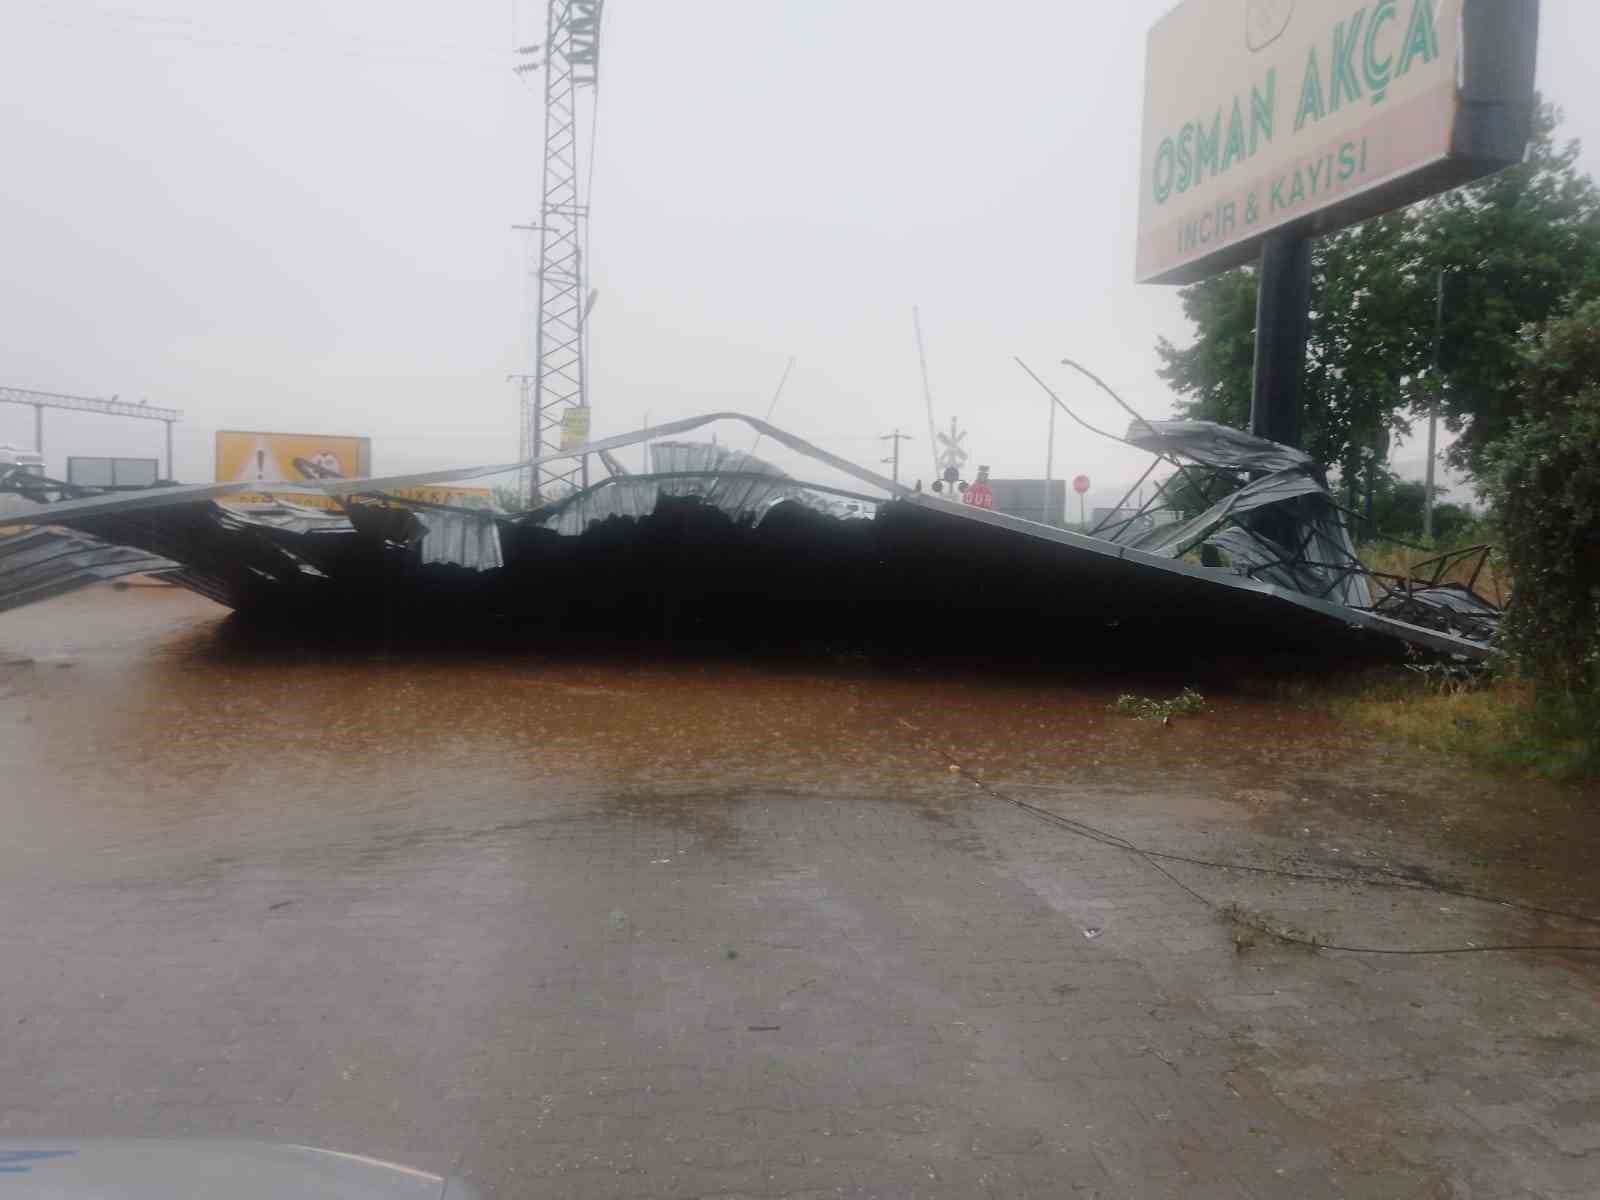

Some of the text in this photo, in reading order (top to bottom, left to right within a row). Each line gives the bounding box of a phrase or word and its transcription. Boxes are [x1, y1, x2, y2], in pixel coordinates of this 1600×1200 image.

[1153, 0, 1440, 204] OSMAN AKÇA
[1245, 192, 1260, 225] &
[1270, 136, 1368, 214] KAYISI
